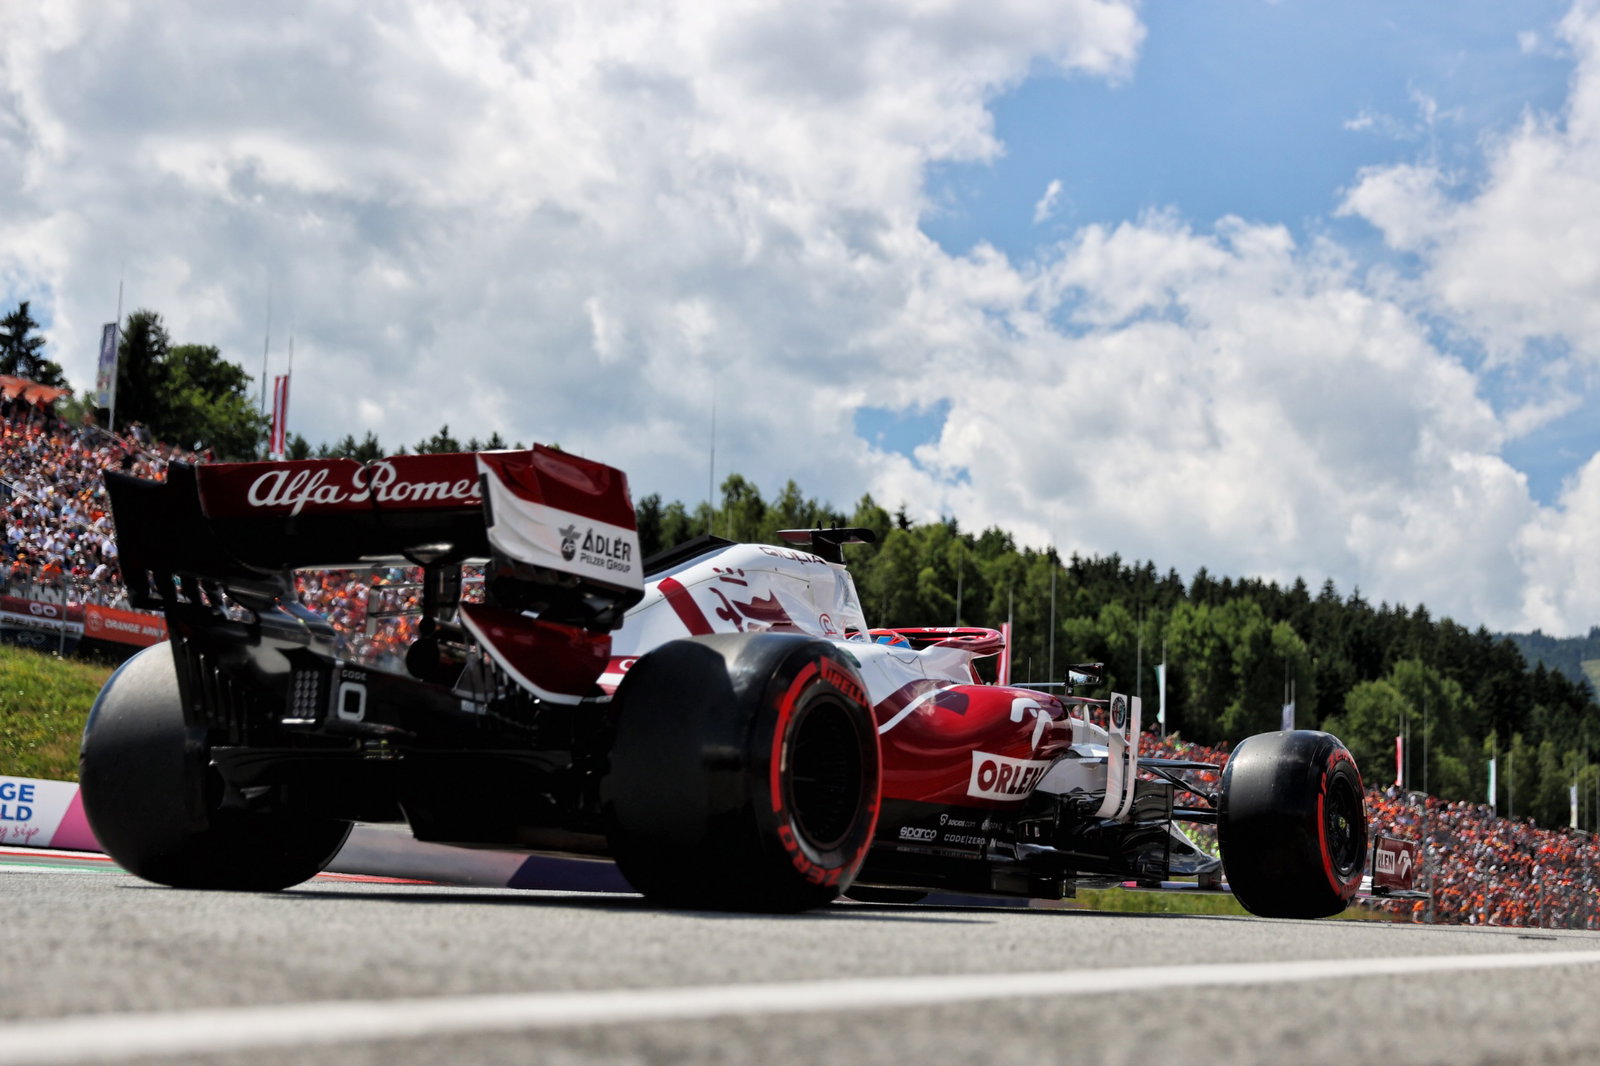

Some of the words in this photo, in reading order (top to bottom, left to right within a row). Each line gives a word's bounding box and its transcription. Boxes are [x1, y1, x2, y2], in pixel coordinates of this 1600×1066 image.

[248, 469, 347, 517] Alfa
[29, 602, 58, 617] GO
[104, 618, 141, 633] ORANGE
[342, 669, 368, 680] CODE
[977, 760, 1044, 794] ORLEN
[12, 823, 39, 844] sip
[899, 826, 937, 841] sparco
